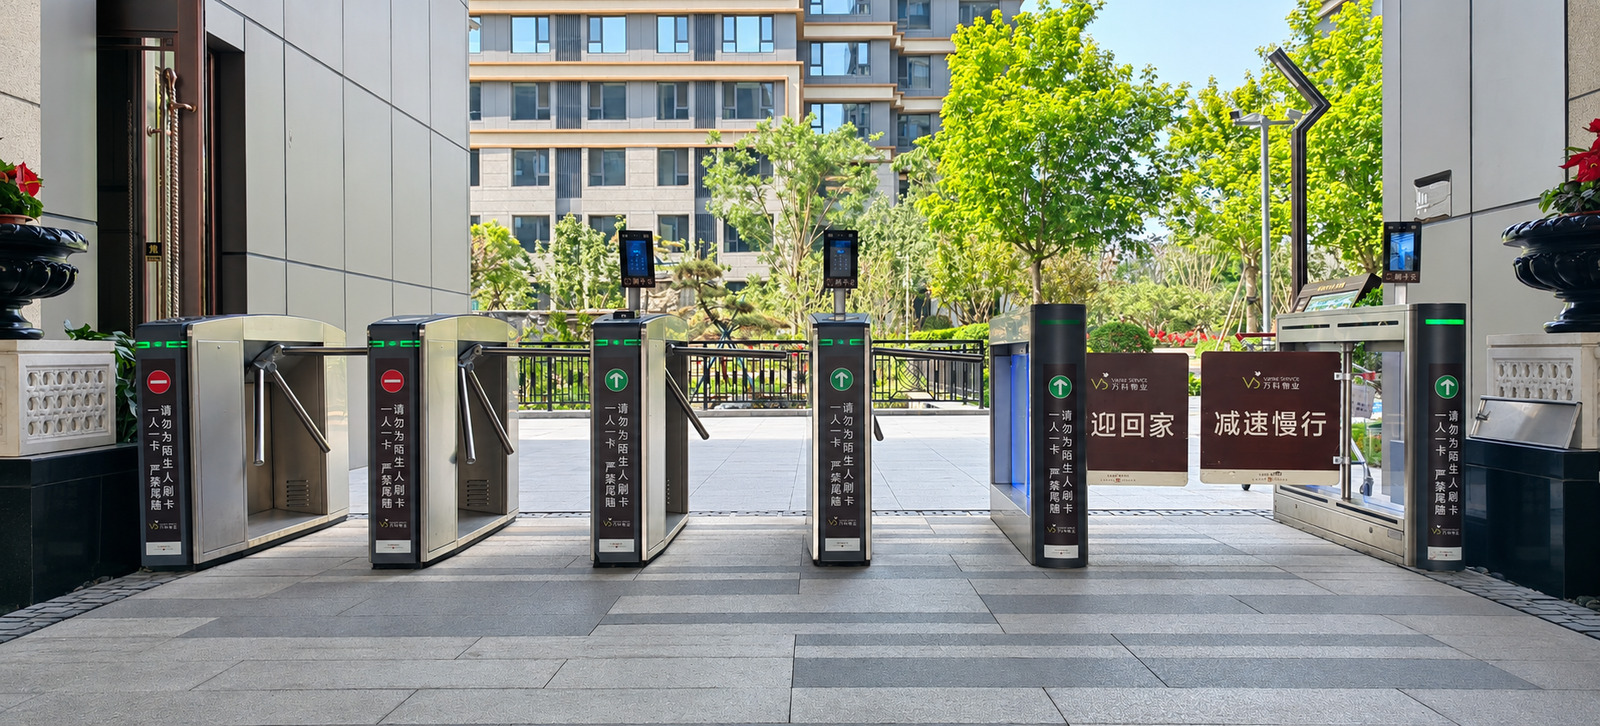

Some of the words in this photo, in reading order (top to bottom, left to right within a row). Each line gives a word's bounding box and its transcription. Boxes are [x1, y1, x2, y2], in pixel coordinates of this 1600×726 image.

[147, 408, 160, 451] 一人一卡
[380, 407, 392, 450] 一人一卡
[604, 406, 616, 449] 一人一卡
[830, 405, 841, 448] 一人一卡
[1048, 413, 1060, 455] 一人一卡
[1091, 412, 1175, 438] 迎回家
[1214, 410, 1327, 437] 减速慢行
[1434, 413, 1446, 457] 一人一卡
